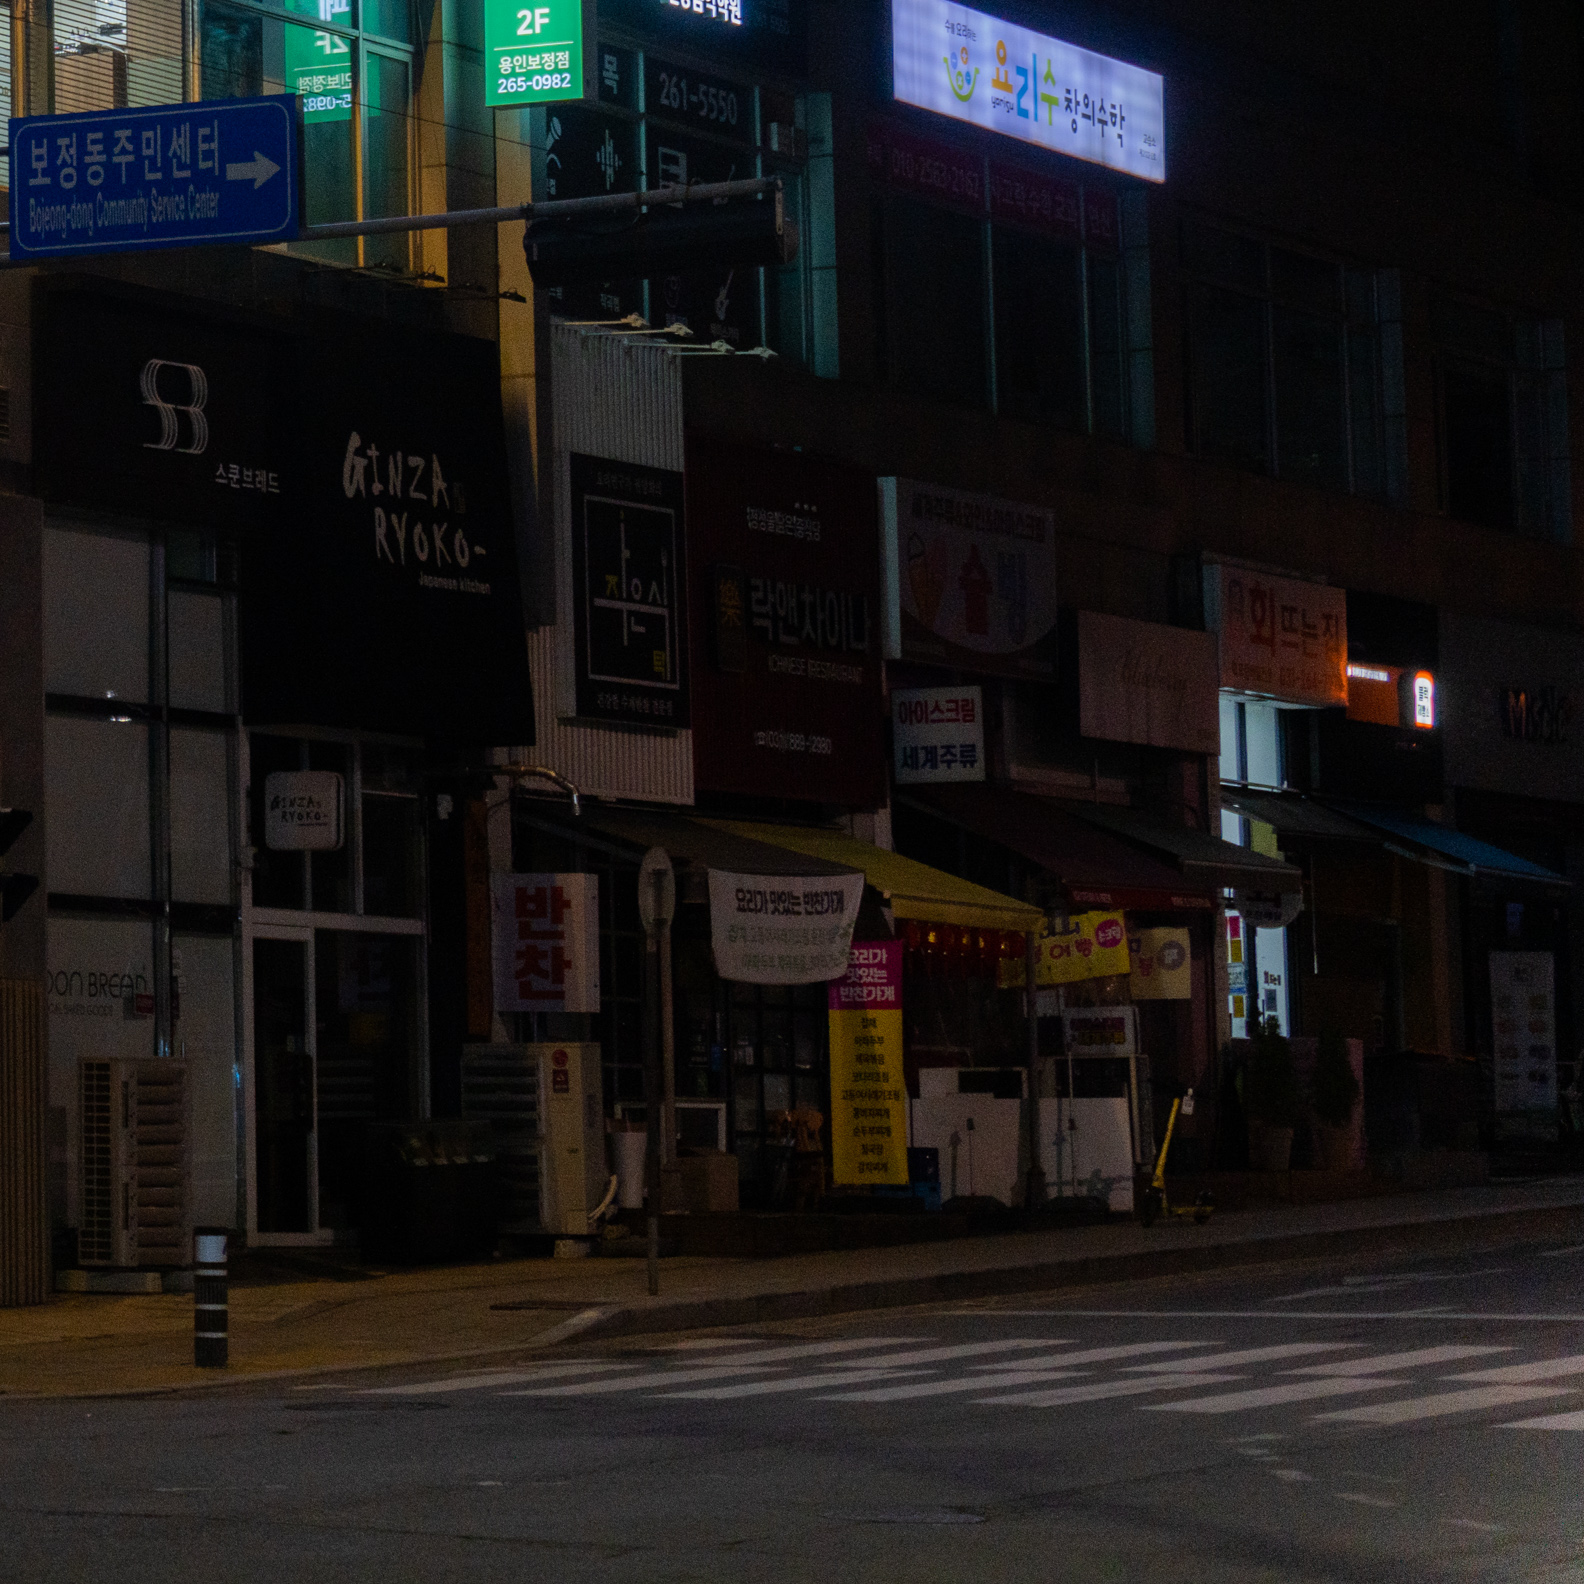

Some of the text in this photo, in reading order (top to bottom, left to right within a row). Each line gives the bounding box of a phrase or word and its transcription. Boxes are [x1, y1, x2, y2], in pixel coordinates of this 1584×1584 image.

[515, 7, 551, 38] 2F
[497, 50, 571, 75] 용인보정점
[496, 72, 573, 95] 265-0982
[657, 71, 739, 126] 261-5550
[28, 119, 220, 191] 보정동주민센터
[28, 183, 220, 240] Bojeong-dong Community Service Center
[214, 462, 281, 496] 스쿤브레드
[342, 429, 451, 510] GINZA
[749, 577, 872, 652] 락앤차이나
[898, 698, 976, 726] 아이스크림
[899, 743, 978, 771] 세계주류
[735, 887, 845, 917] 요리가 맛있는 반찬가게
[514, 885, 573, 1001] 반찬
